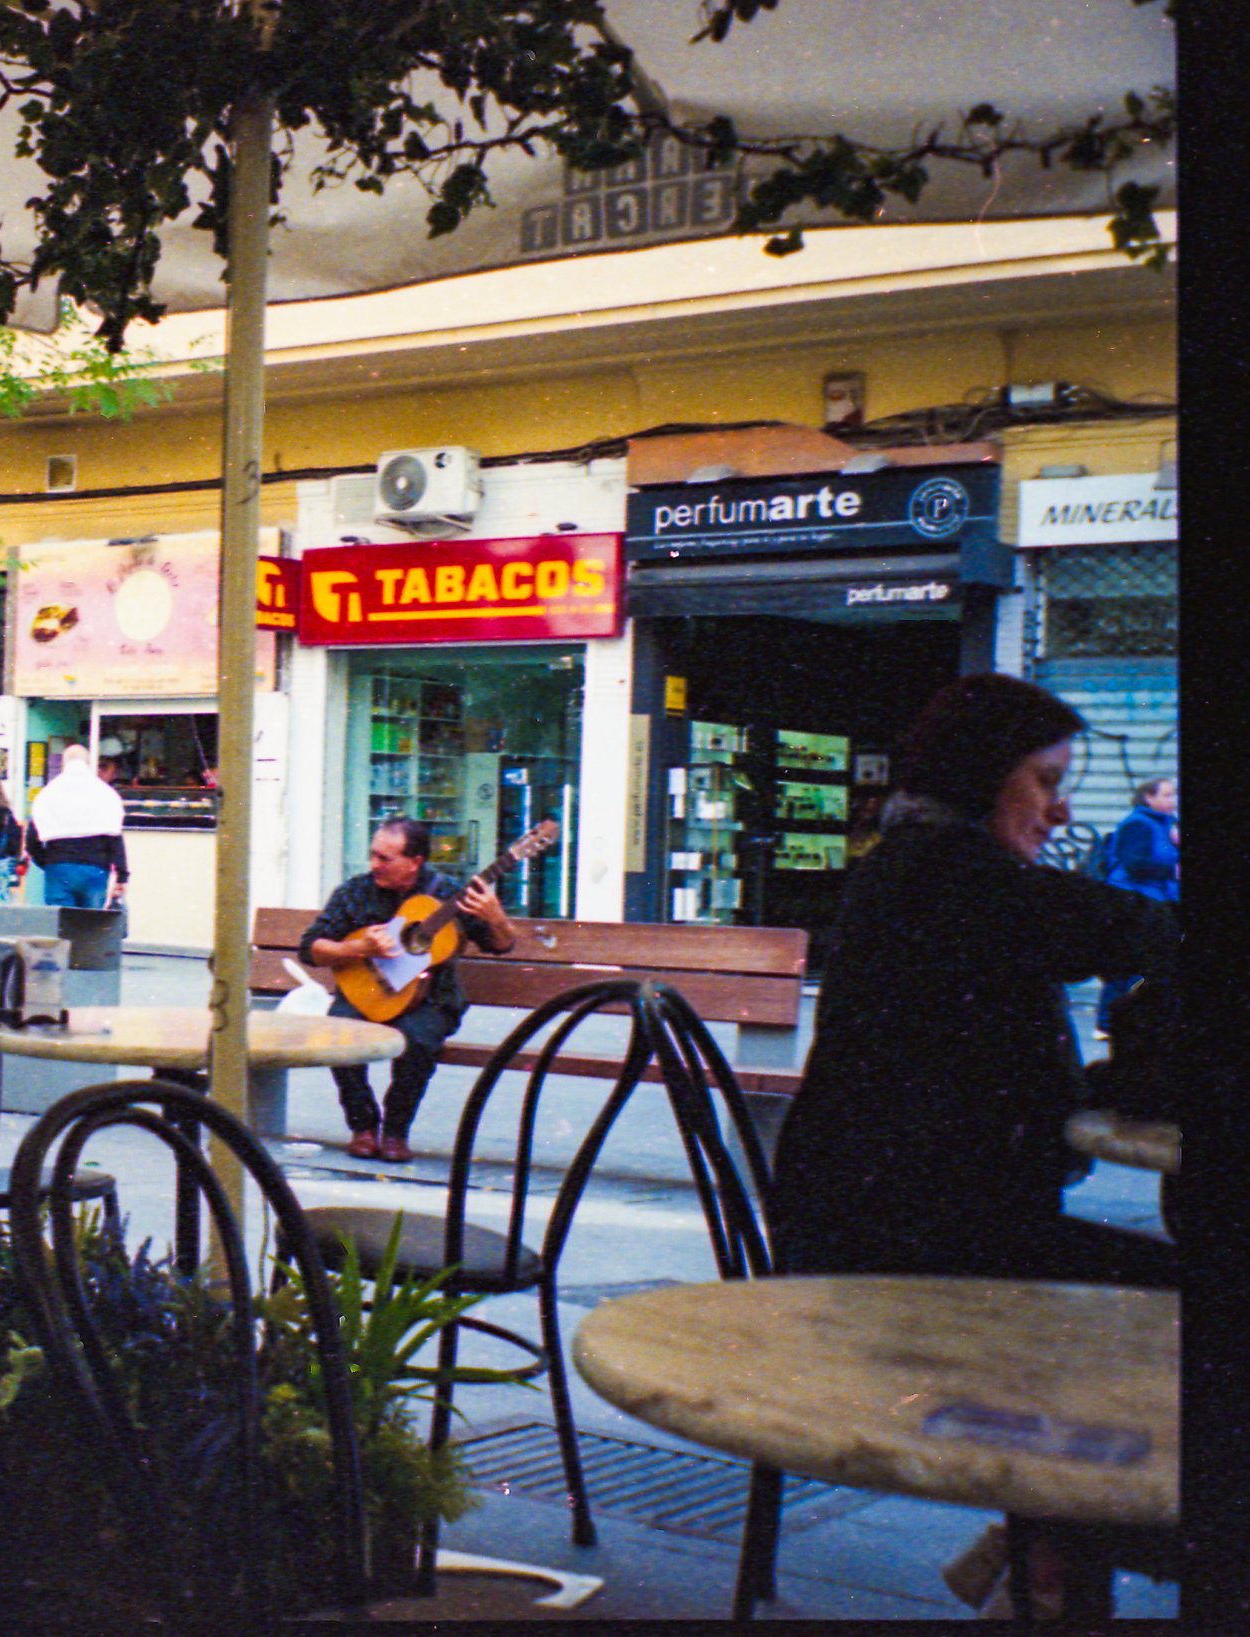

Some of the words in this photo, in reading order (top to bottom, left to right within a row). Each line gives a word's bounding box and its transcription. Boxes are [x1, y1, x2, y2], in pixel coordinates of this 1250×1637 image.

[654, 486, 862, 535] perfumarte
[375, 559, 606, 604] TABACOS
[846, 580, 951, 606] perfumarte
